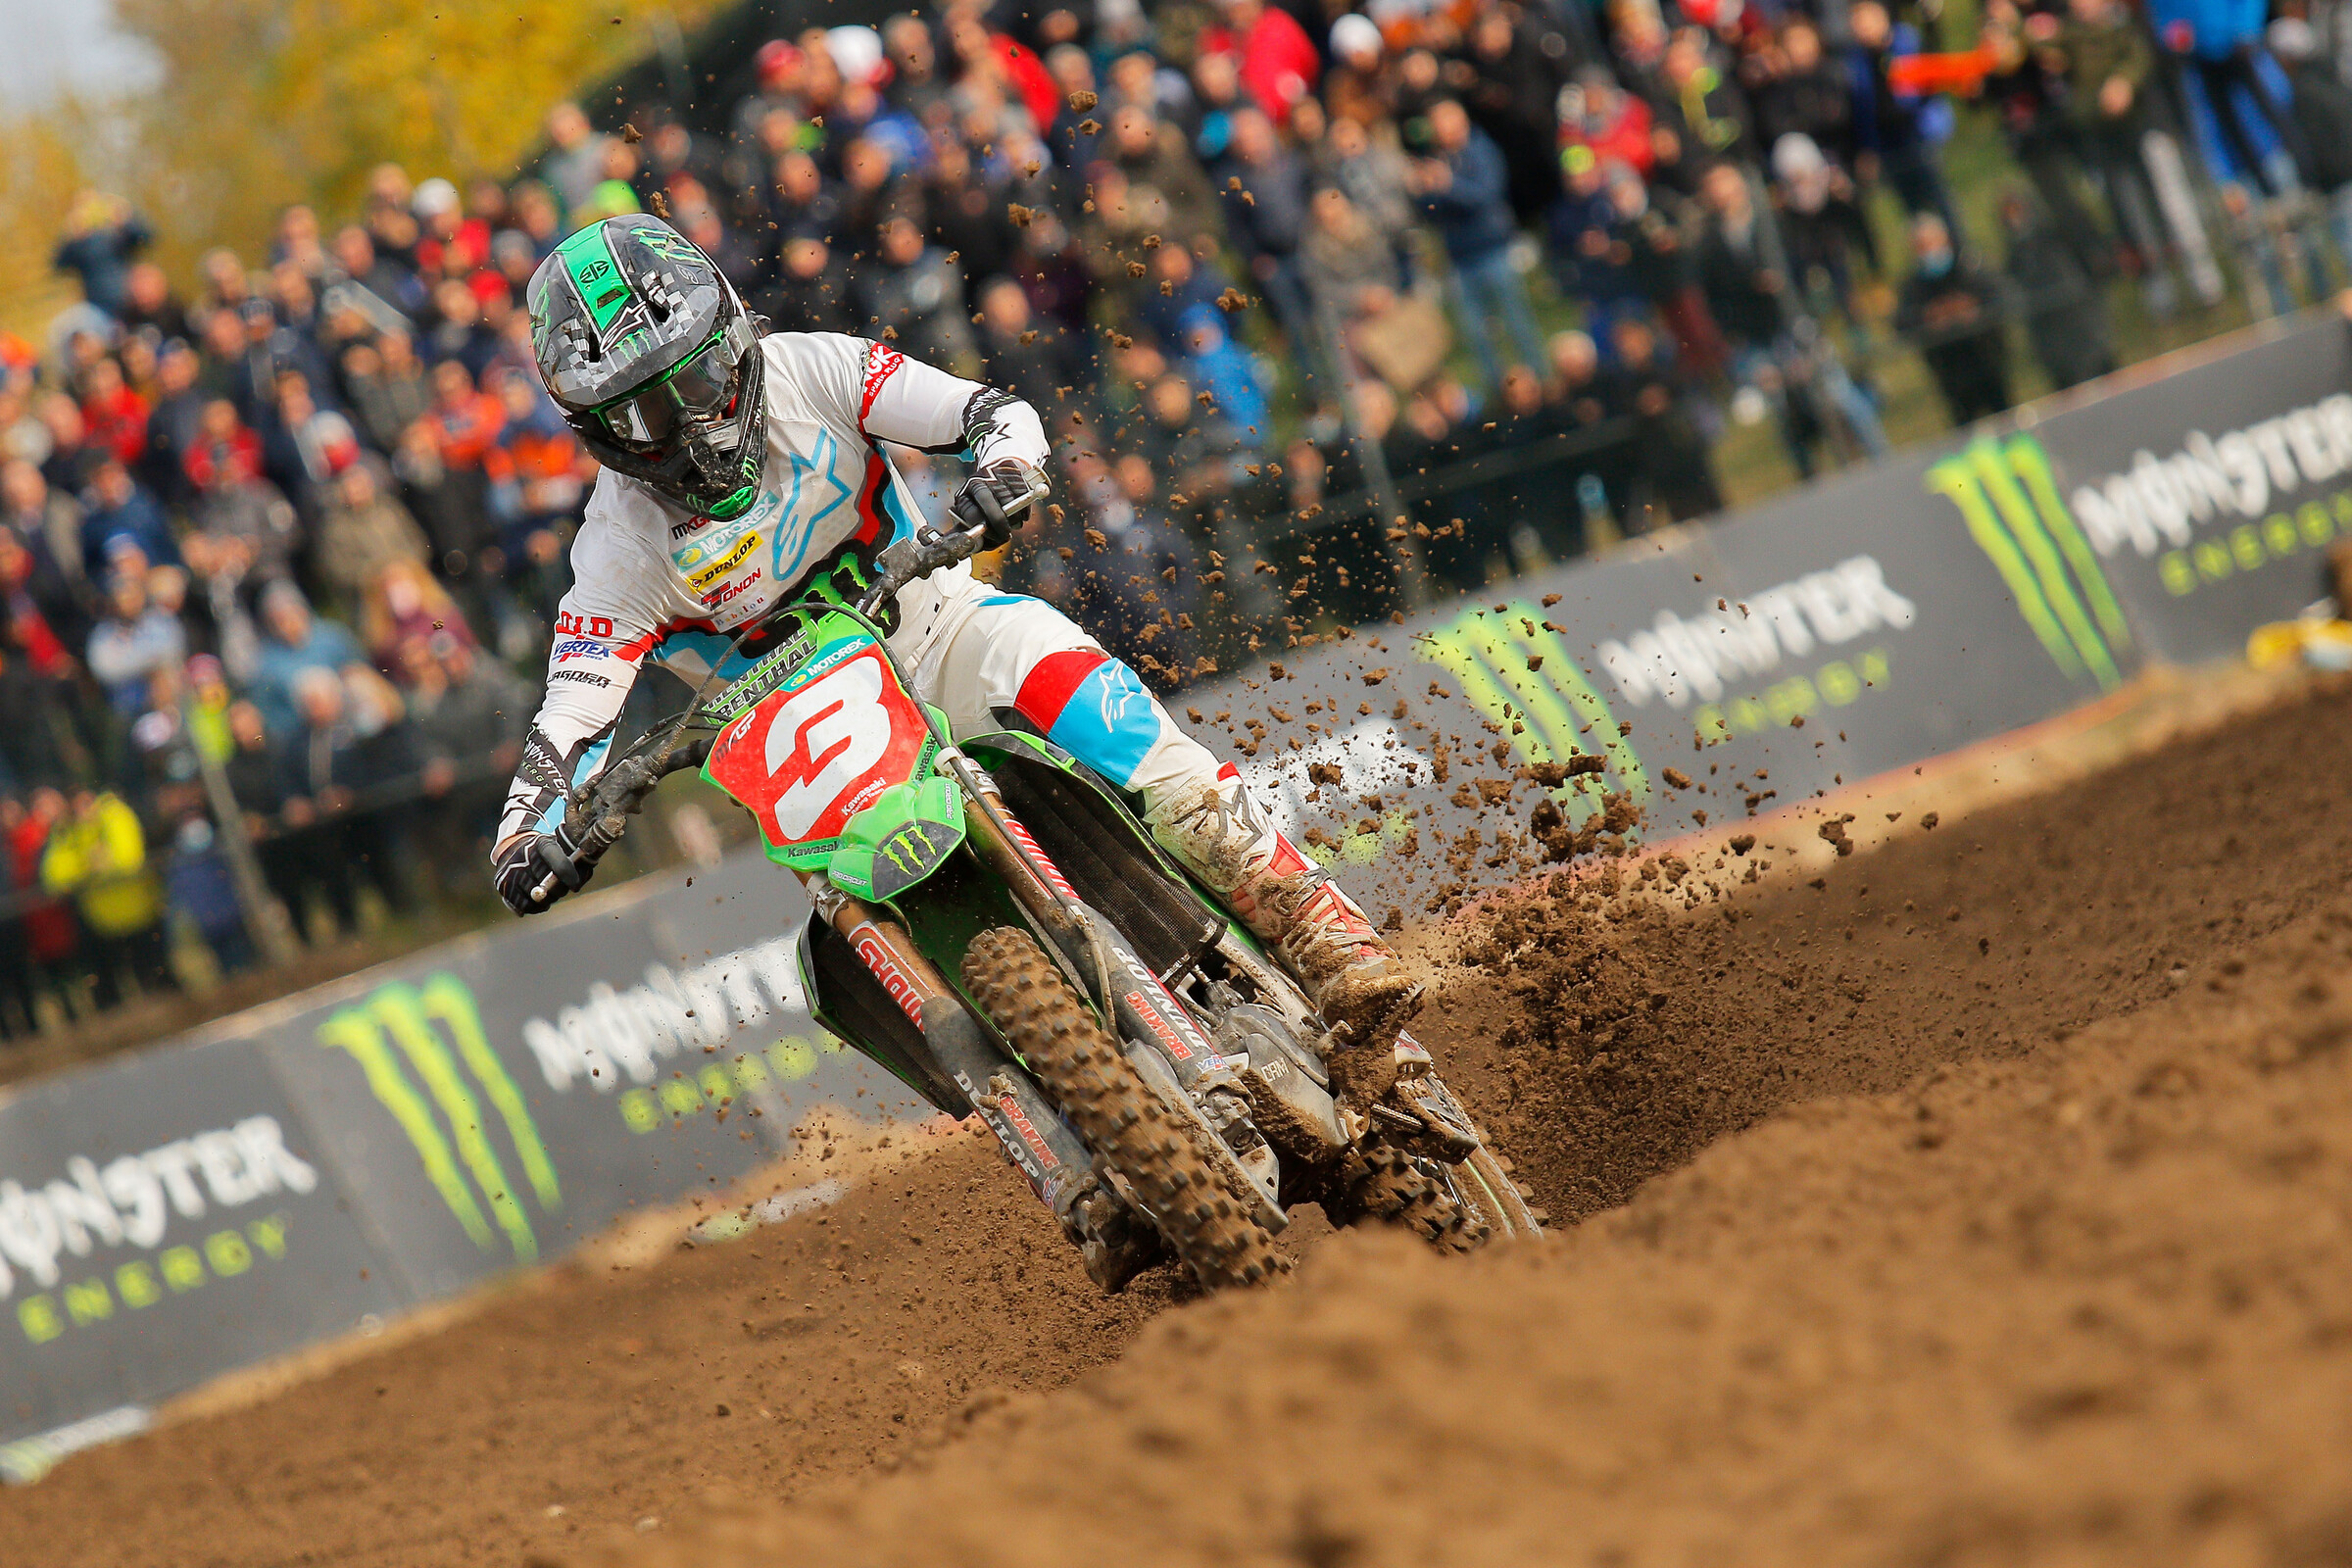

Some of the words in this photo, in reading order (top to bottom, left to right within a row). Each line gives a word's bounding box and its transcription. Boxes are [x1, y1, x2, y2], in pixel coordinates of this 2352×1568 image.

[699, 497, 775, 555] MOTOREX
[704, 535, 756, 582] DUNLOP
[554, 641, 612, 659] VERTEX
[715, 639, 817, 724] RENTHAL
[807, 638, 866, 676] MOTOREX
[765, 657, 891, 841] 3
[915, 734, 937, 781] awasak
[841, 777, 887, 816] Kawasaki
[856, 937, 925, 1034] SHOW
[1112, 947, 1211, 1051] DUNLOP
[1125, 990, 1195, 1061] BRAKING
[999, 1096, 1060, 1171] BRAKING
[0, 1114, 318, 1299] ONSTER
